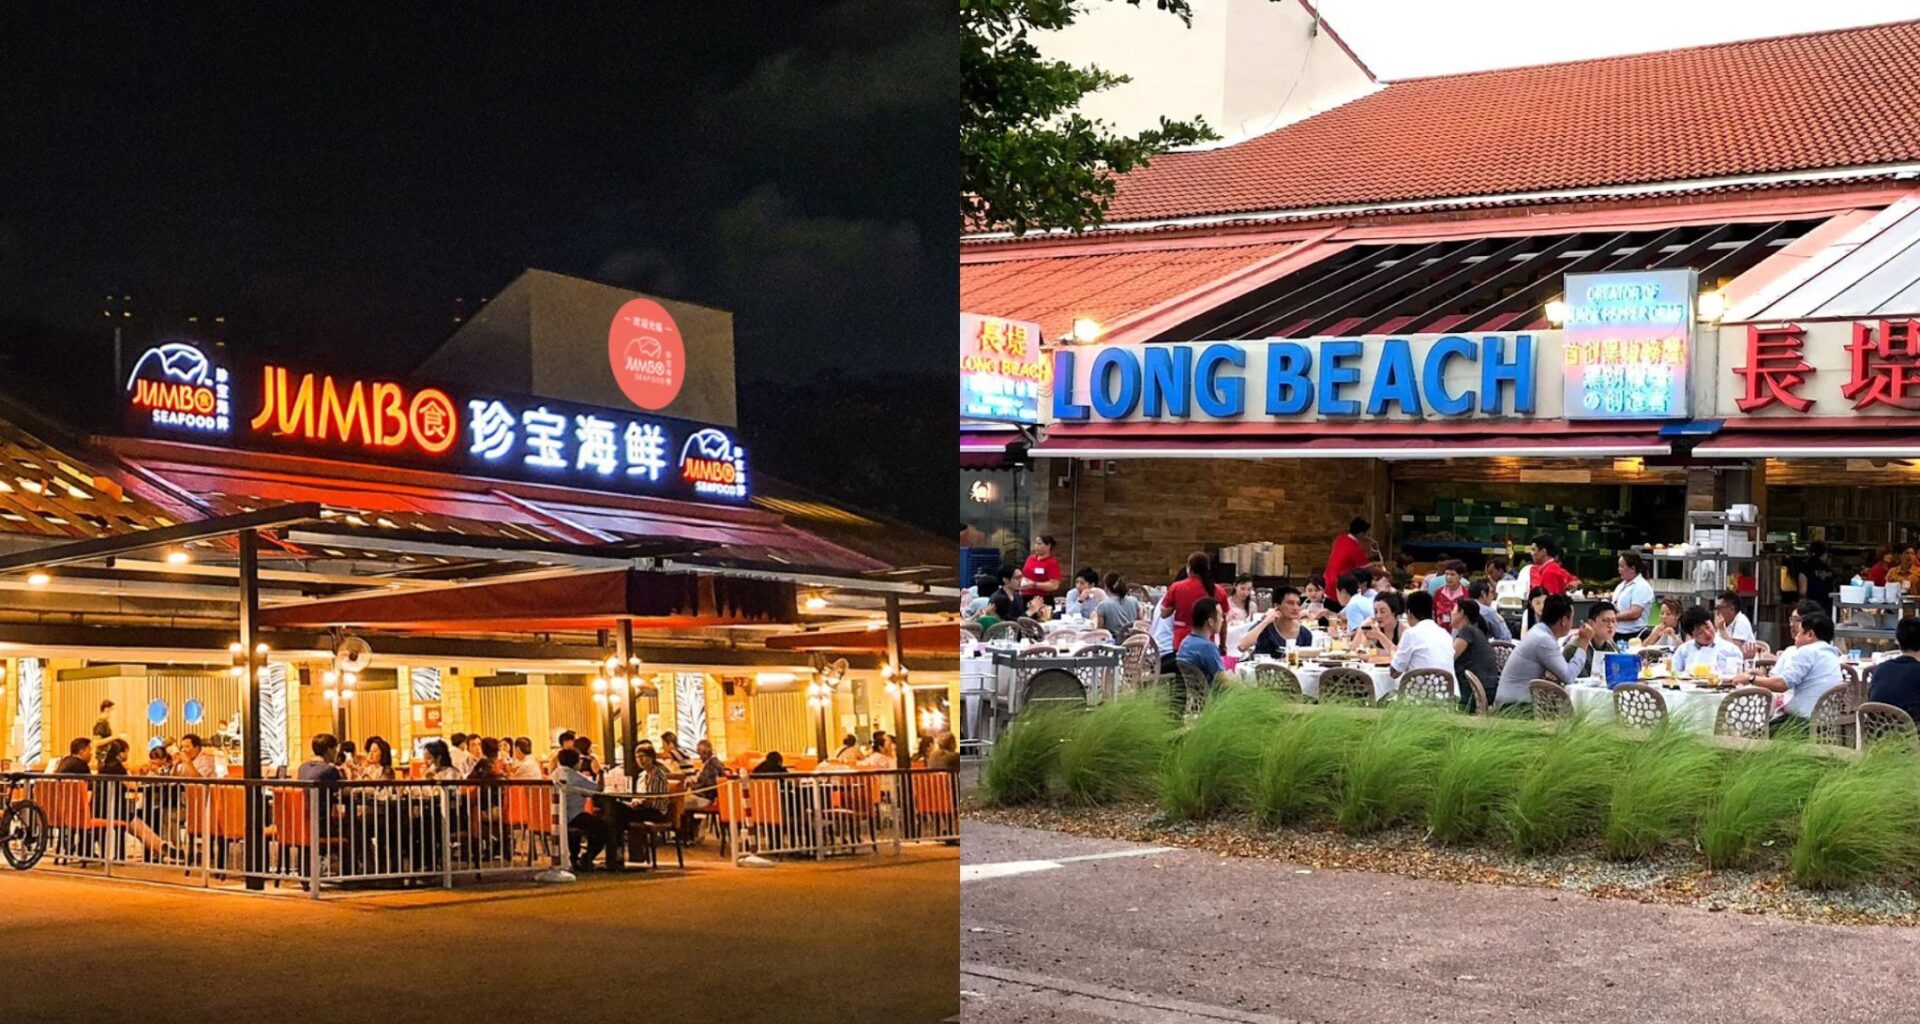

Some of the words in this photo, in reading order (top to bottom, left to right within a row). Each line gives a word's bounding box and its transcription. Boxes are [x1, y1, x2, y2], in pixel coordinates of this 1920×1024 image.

[1566, 306, 1601, 323] LACK
[976, 321, 1028, 358] 長堤
[1053, 343, 1246, 420] LONG
[1265, 335, 1537, 418] BEACH
[1732, 318, 1920, 414] 長堤
[132, 378, 215, 413] JUMBO
[152, 409, 215, 430] SEAFOOD
[468, 399, 667, 480] 珍宝海鲜
[683, 457, 735, 483] JUMBO
